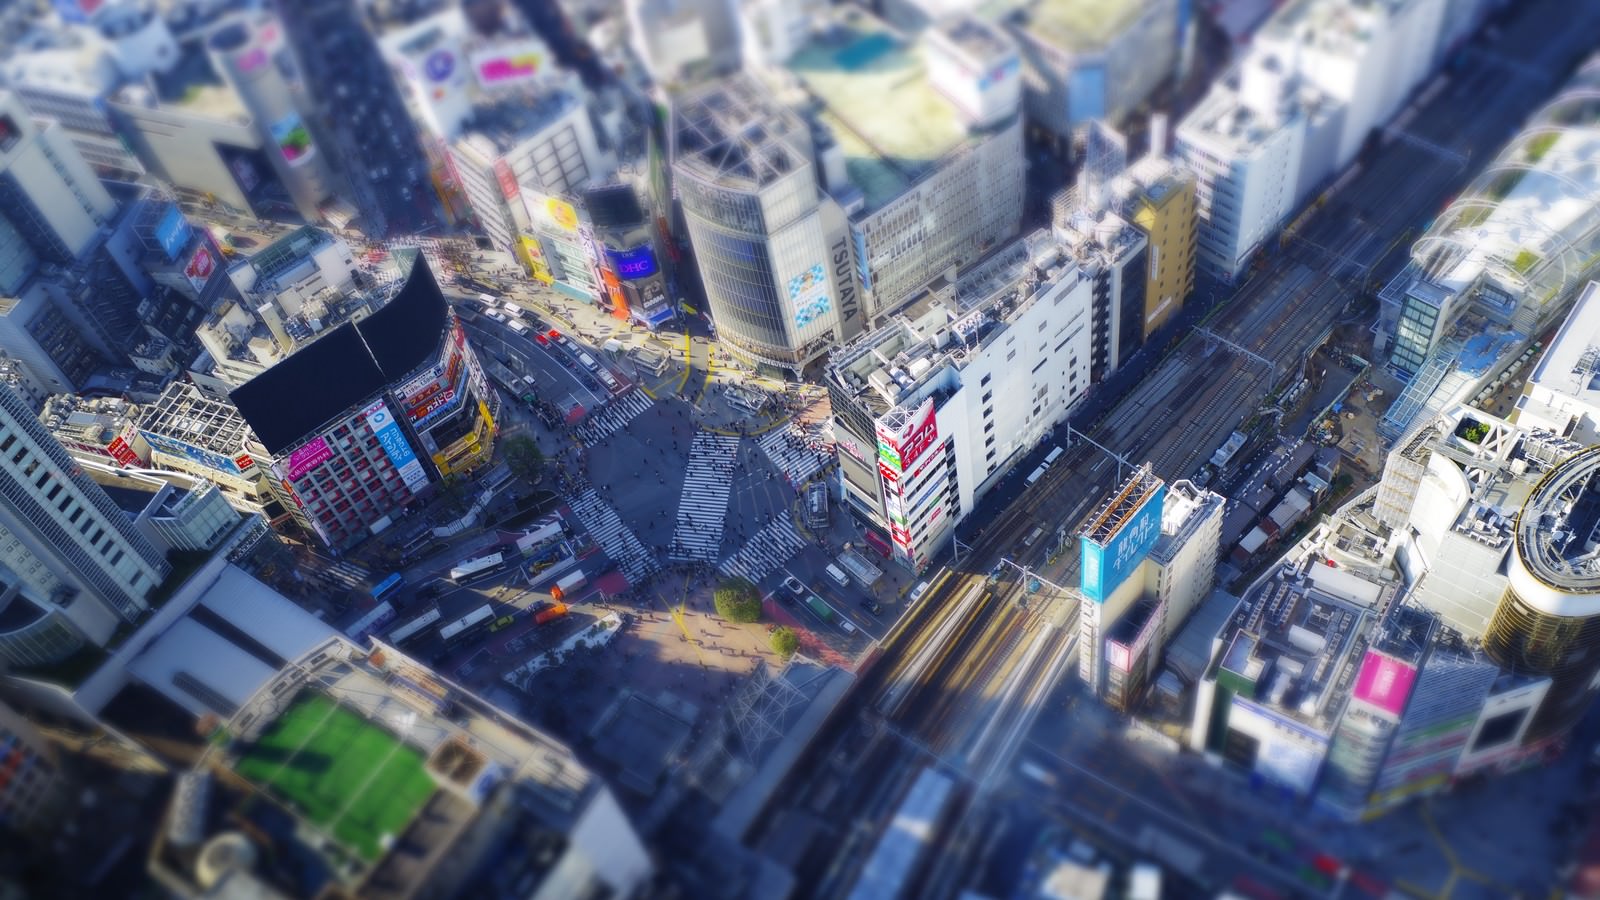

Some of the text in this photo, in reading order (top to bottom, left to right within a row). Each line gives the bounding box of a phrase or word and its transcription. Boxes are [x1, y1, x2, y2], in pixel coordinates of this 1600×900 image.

[621, 260, 648, 272] DHC
[832, 236, 858, 322] TSUTAYA
[903, 423, 935, 460] アコム
